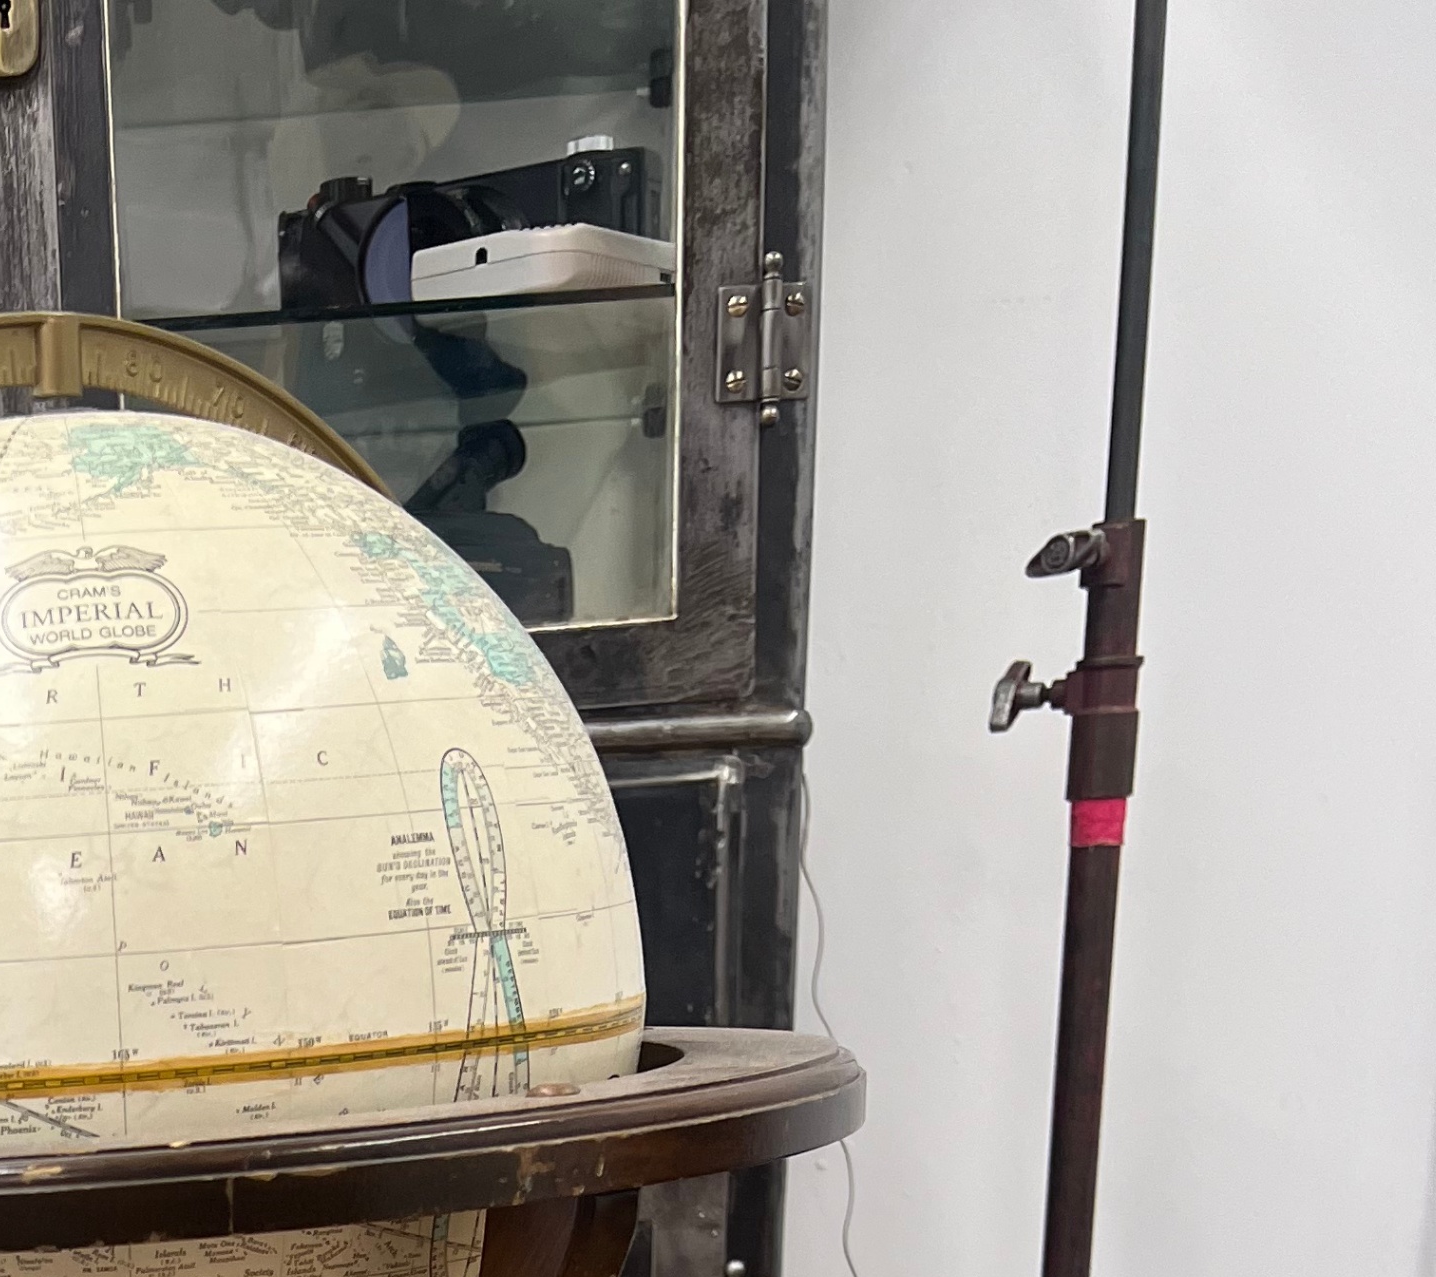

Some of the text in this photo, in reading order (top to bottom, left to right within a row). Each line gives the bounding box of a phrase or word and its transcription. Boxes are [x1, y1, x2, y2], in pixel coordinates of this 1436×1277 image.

[57, 586, 121, 600] CRAM'S
[20, 601, 163, 629] IMPERIAL
[29, 624, 157, 646] WORLD GLOBE
